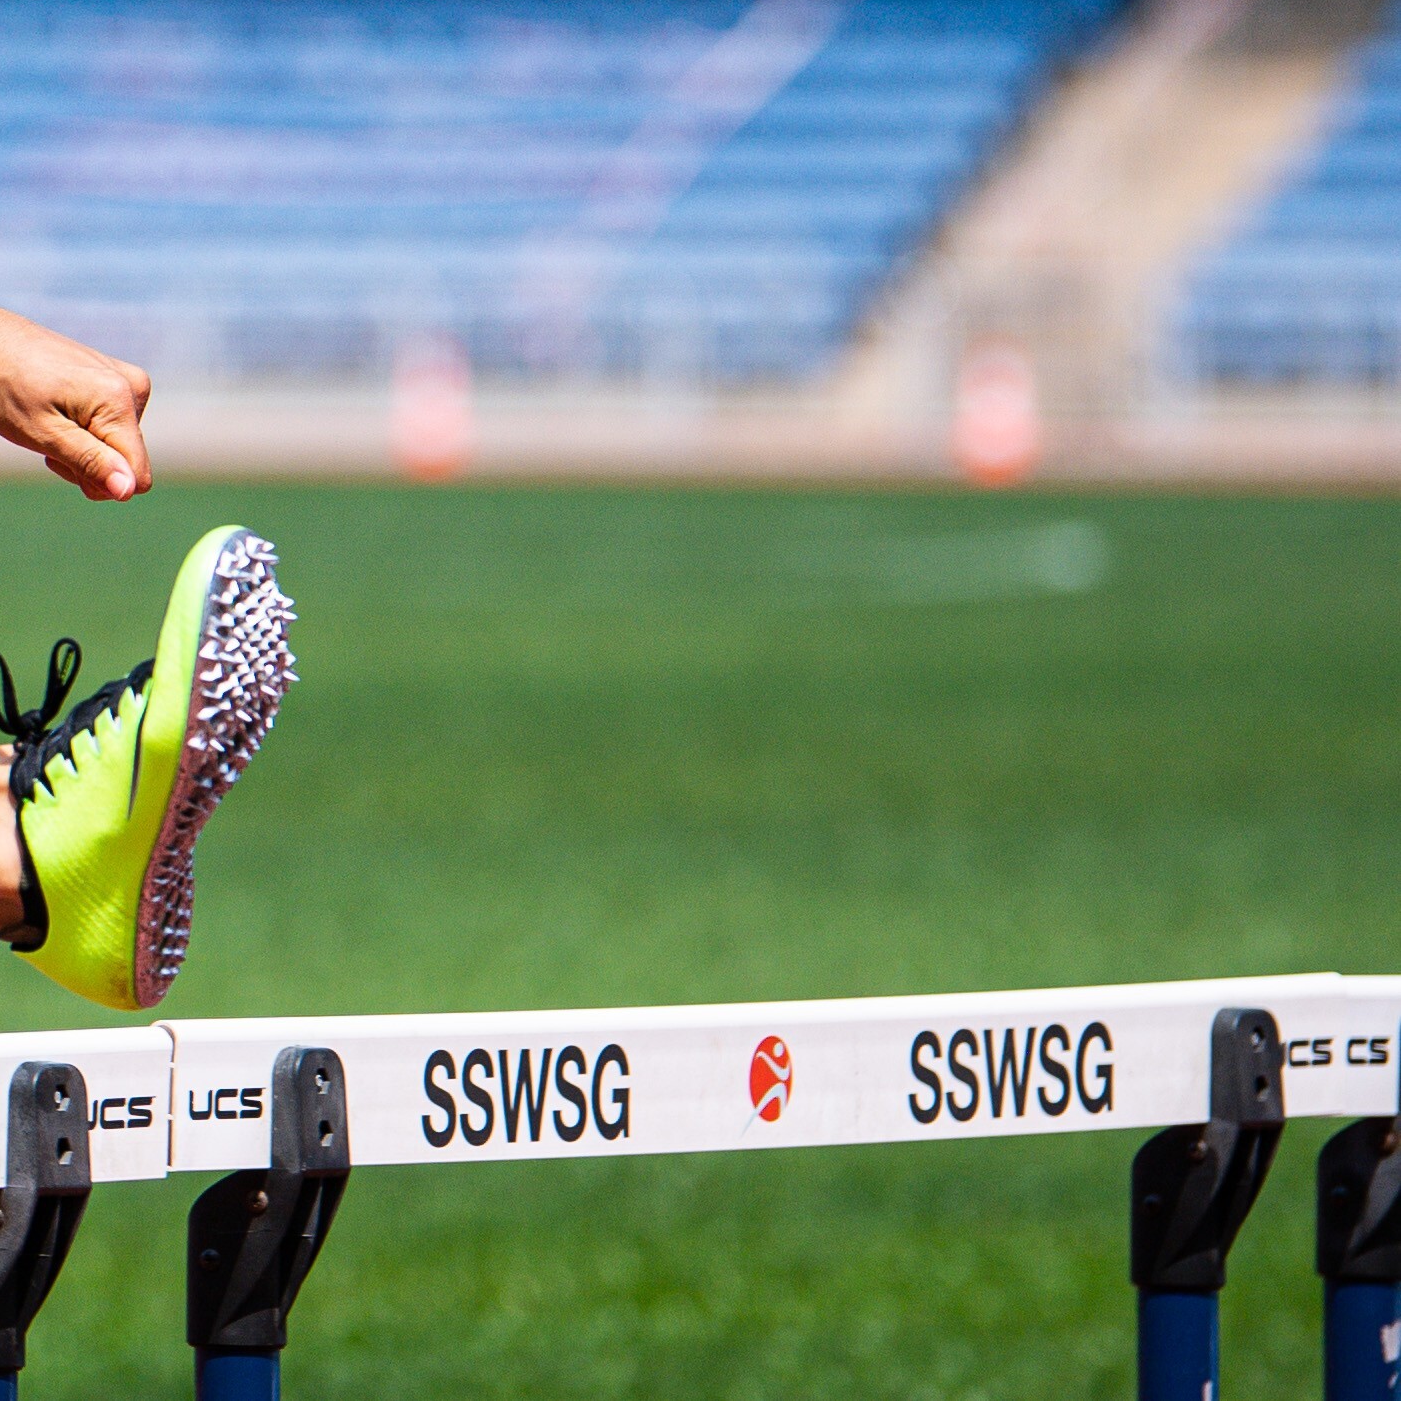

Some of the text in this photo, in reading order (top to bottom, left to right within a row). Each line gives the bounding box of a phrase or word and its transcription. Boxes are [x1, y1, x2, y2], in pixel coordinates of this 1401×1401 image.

[189, 1021, 1334, 1149] UCS SSWSG SSWSG CS
[1347, 1038, 1390, 1065] CS
